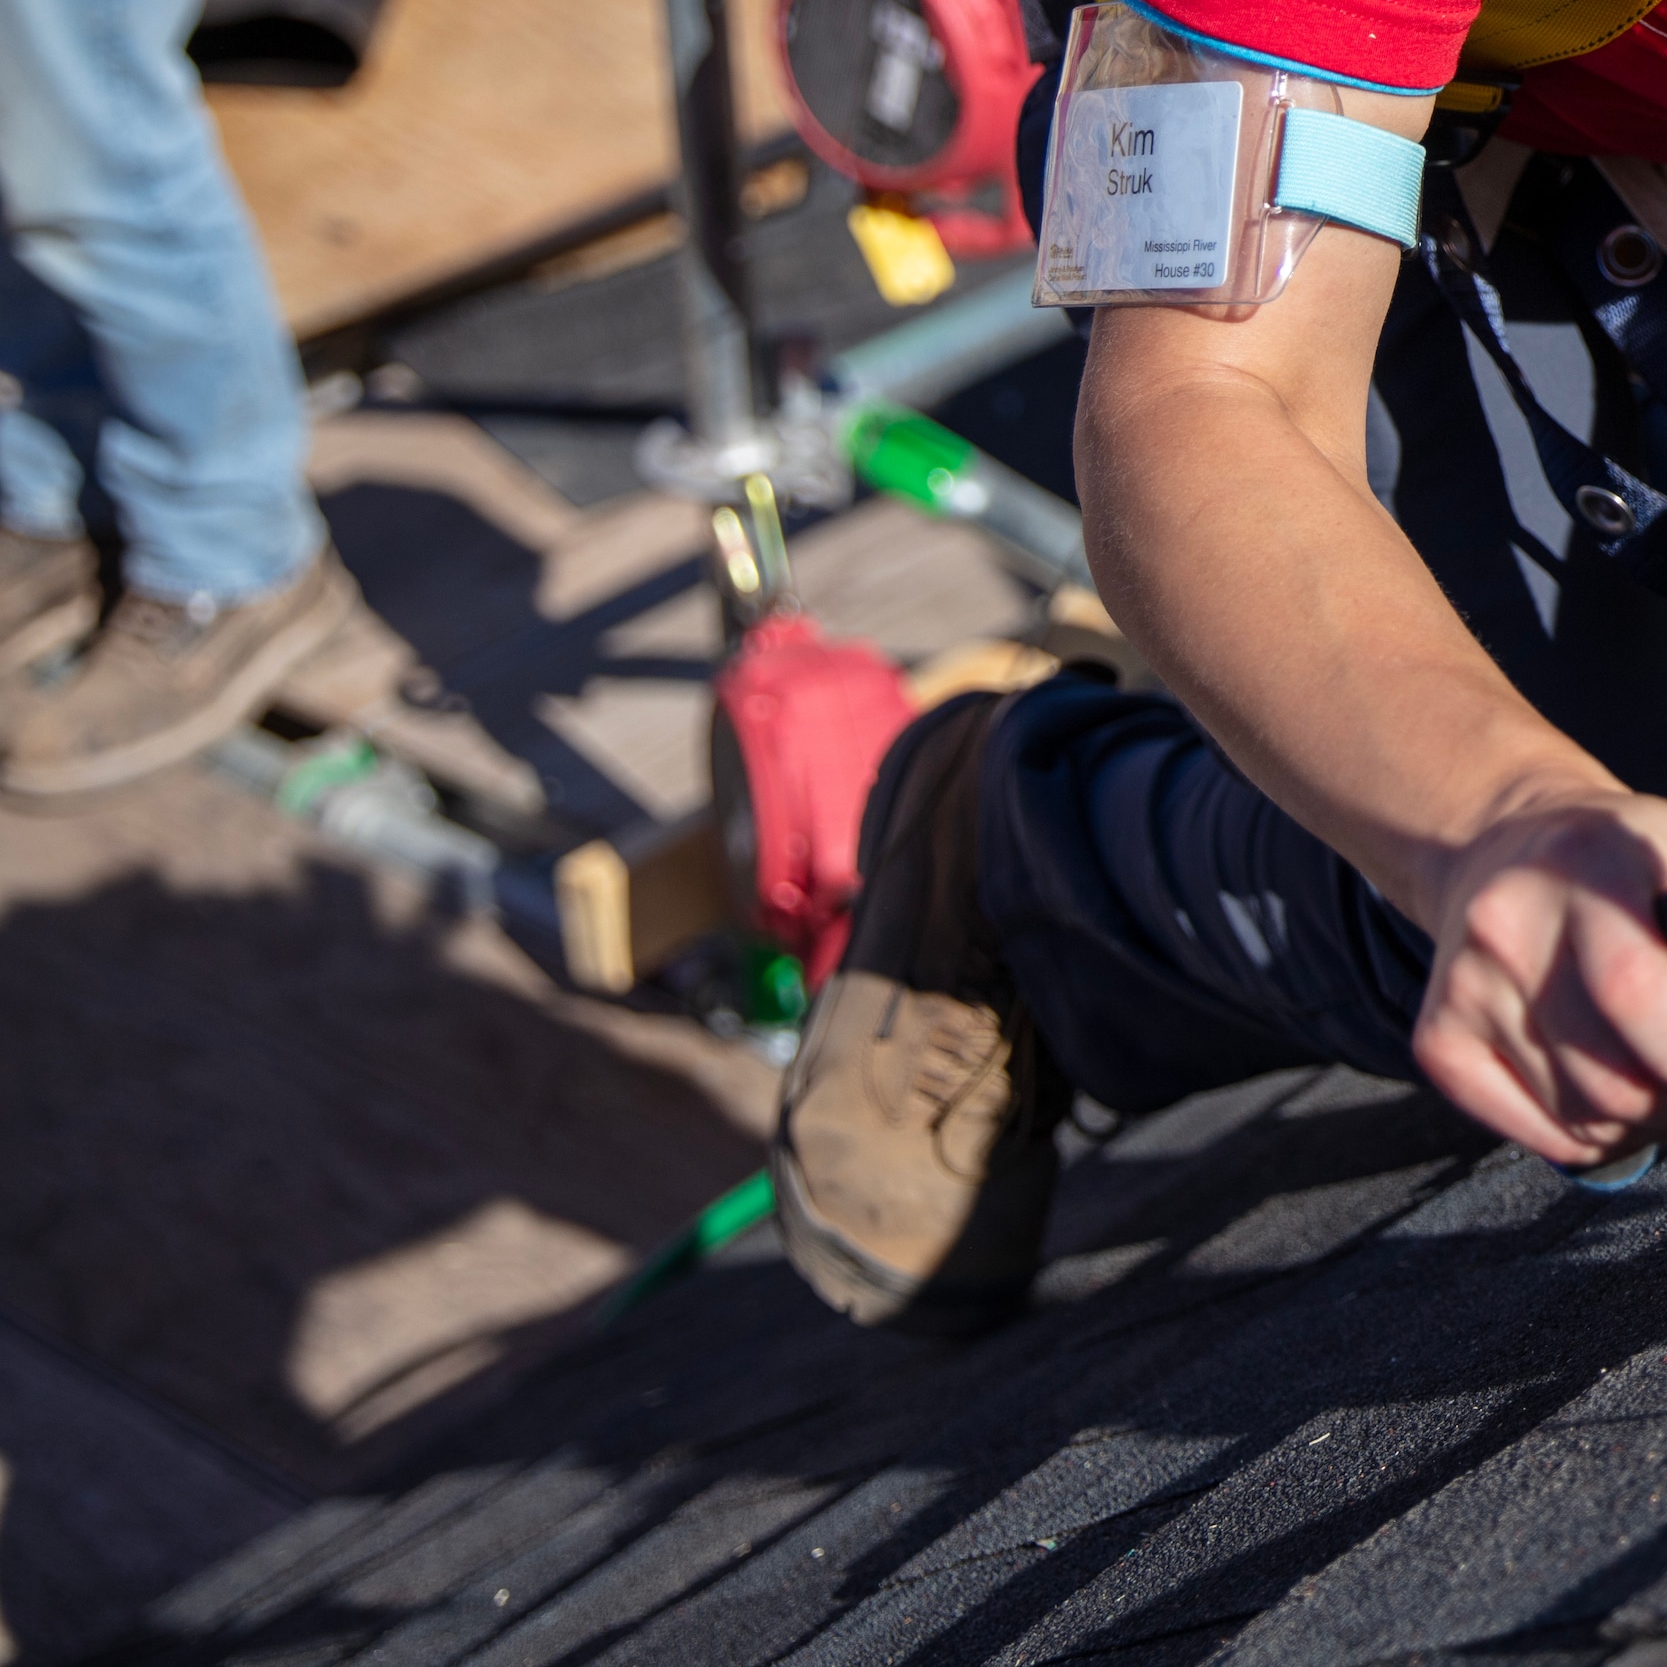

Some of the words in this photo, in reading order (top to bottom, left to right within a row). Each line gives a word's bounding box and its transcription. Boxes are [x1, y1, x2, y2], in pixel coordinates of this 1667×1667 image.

[1110, 121, 1155, 157] Kim
[1106, 167, 1153, 196] Struk
[1144, 239, 1192, 255] Mississippi
[1192, 238, 1217, 253] River
[1154, 263, 1190, 279] House
[1192, 262, 1215, 278] #30
